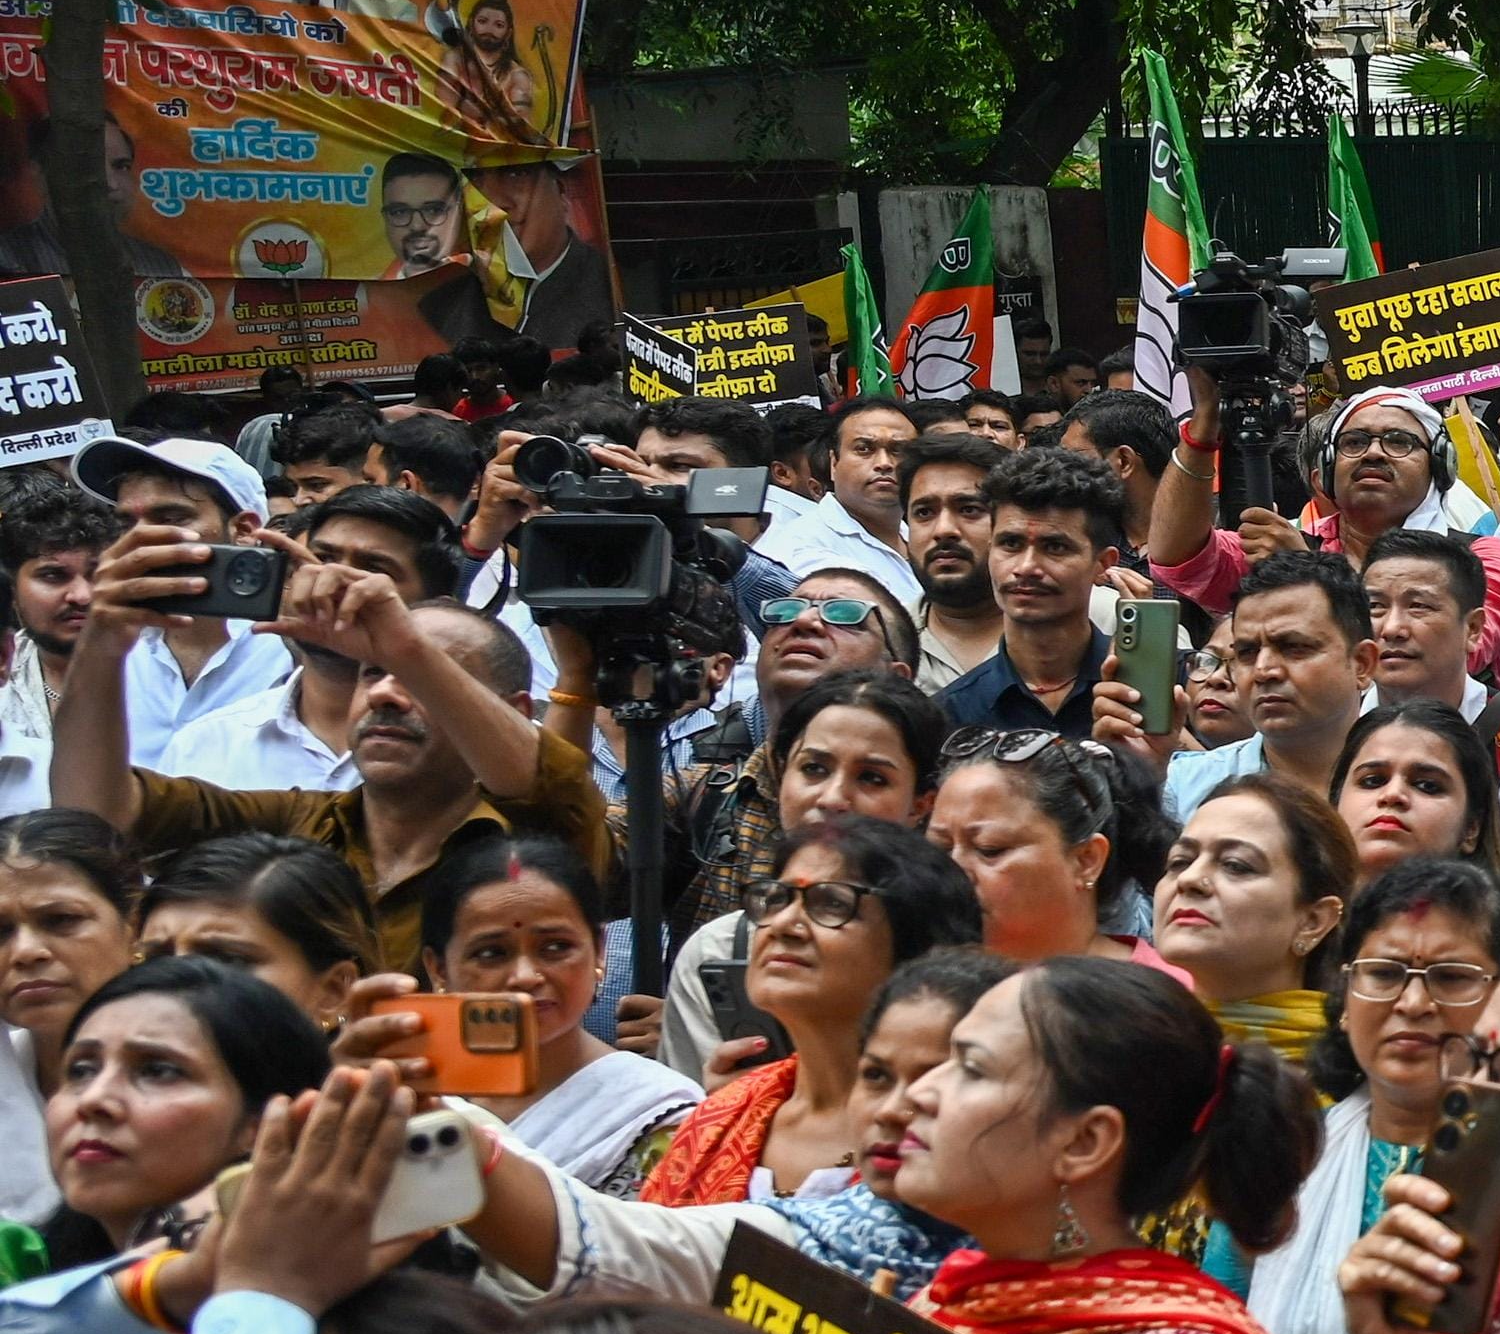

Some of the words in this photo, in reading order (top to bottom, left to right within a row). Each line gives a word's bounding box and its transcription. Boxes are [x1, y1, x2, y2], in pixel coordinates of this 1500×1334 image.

[303, 18, 348, 44] को
[135, 40, 300, 113] परशुराम
[305, 51, 421, 107] जयंती
[156, 98, 189, 118] की
[190, 121, 320, 166] हार्दिक
[141, 163, 376, 218] शुभकामनाएं
[258, 303, 279, 316] वेद
[328, 297, 358, 312] टंडन
[998, 292, 1032, 313] गुप्ता
[1334, 302, 1378, 343] युवा
[1377, 292, 1412, 332] पूछ
[1410, 285, 1448, 315] रहा
[2, 300, 67, 345] करो,
[685, 320, 704, 345] में
[705, 320, 744, 342] पेपर
[745, 312, 788, 339] लीक
[311, 340, 377, 362] समिति
[727, 341, 795, 370] इस्तीफ़ा
[1342, 351, 1382, 382] कब
[1381, 332, 1458, 372] मिलेगा
[15, 356, 83, 409] करो
[1, 434, 43, 455] दिल्ली
[44, 431, 77, 448] प्रदेश
